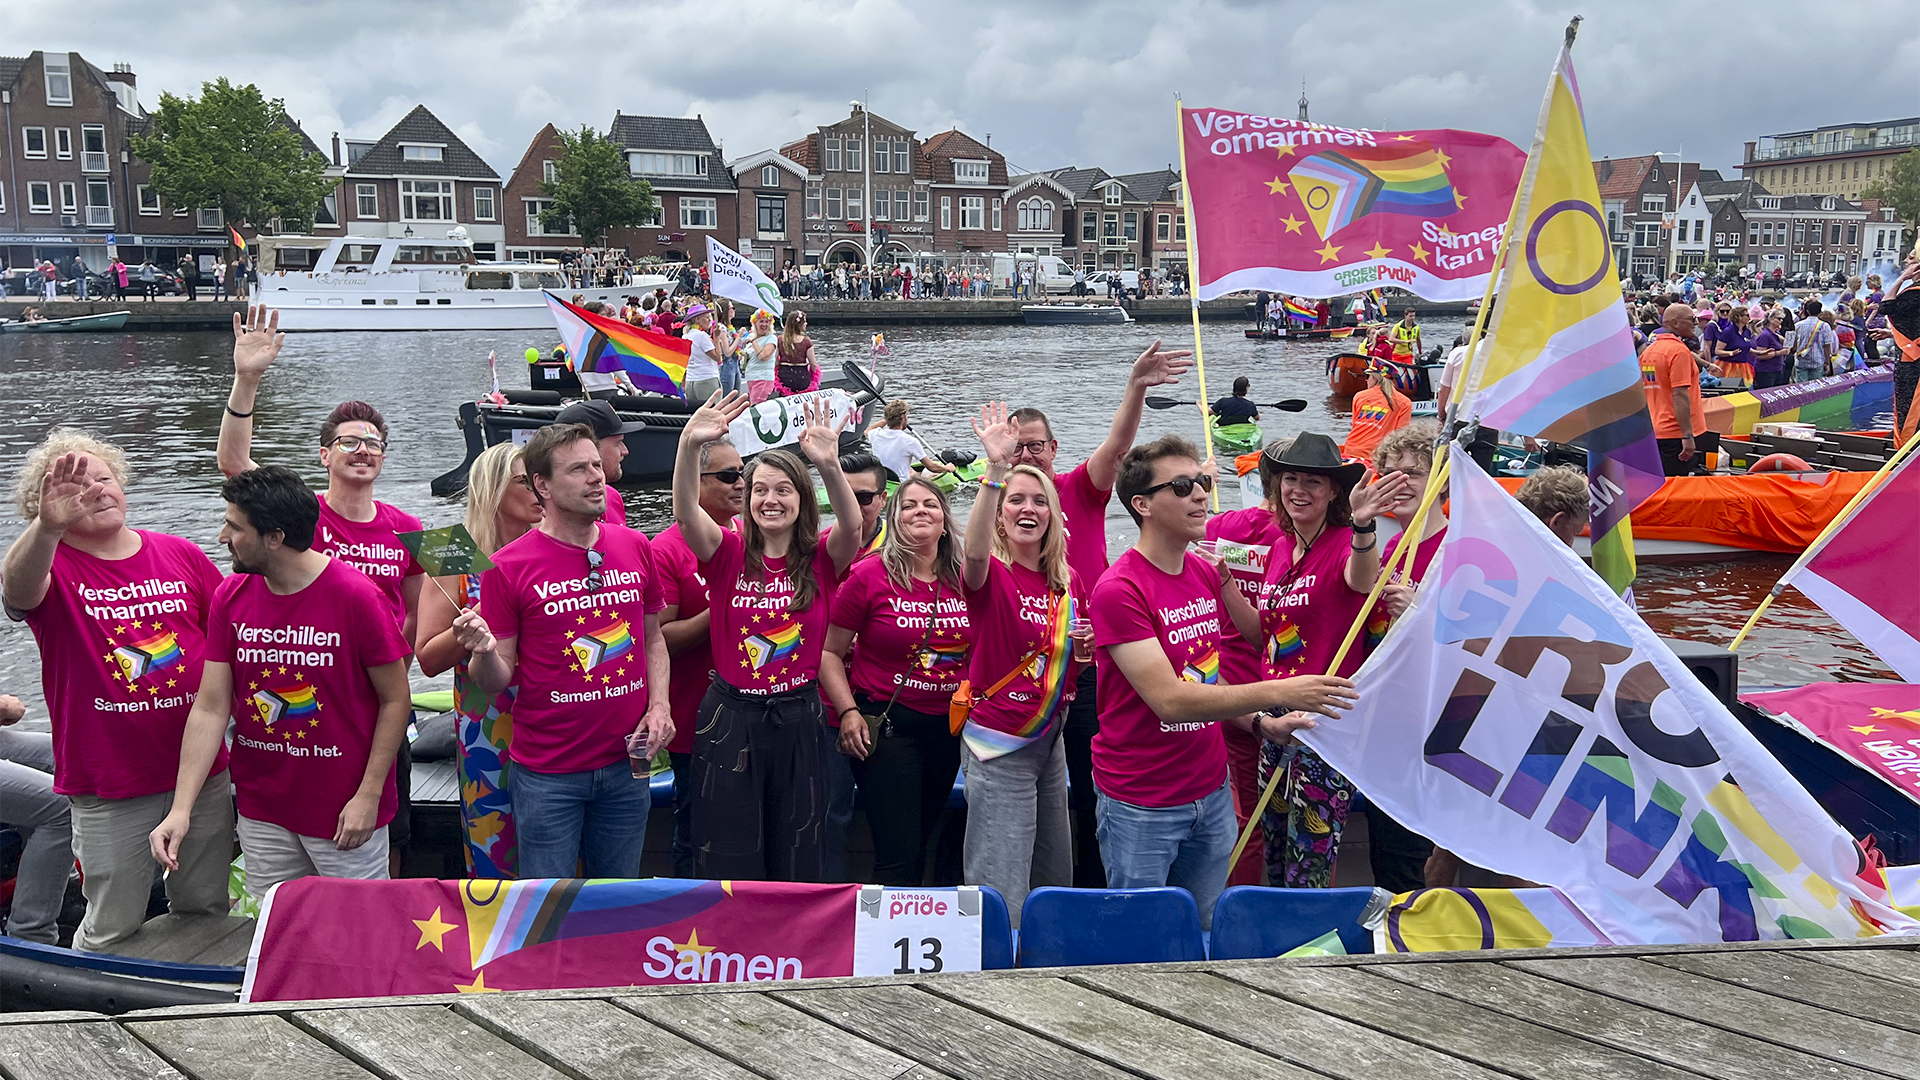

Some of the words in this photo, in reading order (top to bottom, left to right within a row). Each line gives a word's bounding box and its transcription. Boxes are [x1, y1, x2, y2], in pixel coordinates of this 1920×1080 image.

[1210, 129, 1377, 156] omarmen
[1436, 244, 1484, 270] kan
[1334, 265, 1378, 281] GROEN
[1341, 273, 1378, 287] LINKS
[793, 412, 805, 427] de
[322, 526, 404, 561] Vschillen
[1222, 545, 1248, 557] ROEN
[322, 548, 400, 577] ormen
[1226, 554, 1248, 565] INKS
[533, 569, 641, 600] Verscillen
[544, 588, 639, 616] omarmen
[888, 597, 967, 613] Verschille
[1158, 597, 1217, 626] Verschillen
[896, 616, 970, 628] omarme
[232, 622, 341, 647] Verschillen
[237, 646, 334, 667] omarmen
[550, 689, 601, 703] Samen
[605, 686, 628, 698] kan
[940, 682, 959, 691] kan
[94, 697, 149, 712] Samen
[154, 697, 183, 710] kan
[238, 734, 289, 752] Samen
[287, 742, 309, 757] kan
[314, 745, 342, 757] het.
[890, 897, 948, 920] pride
[643, 936, 802, 983] Samen
[893, 937, 943, 975] 13
